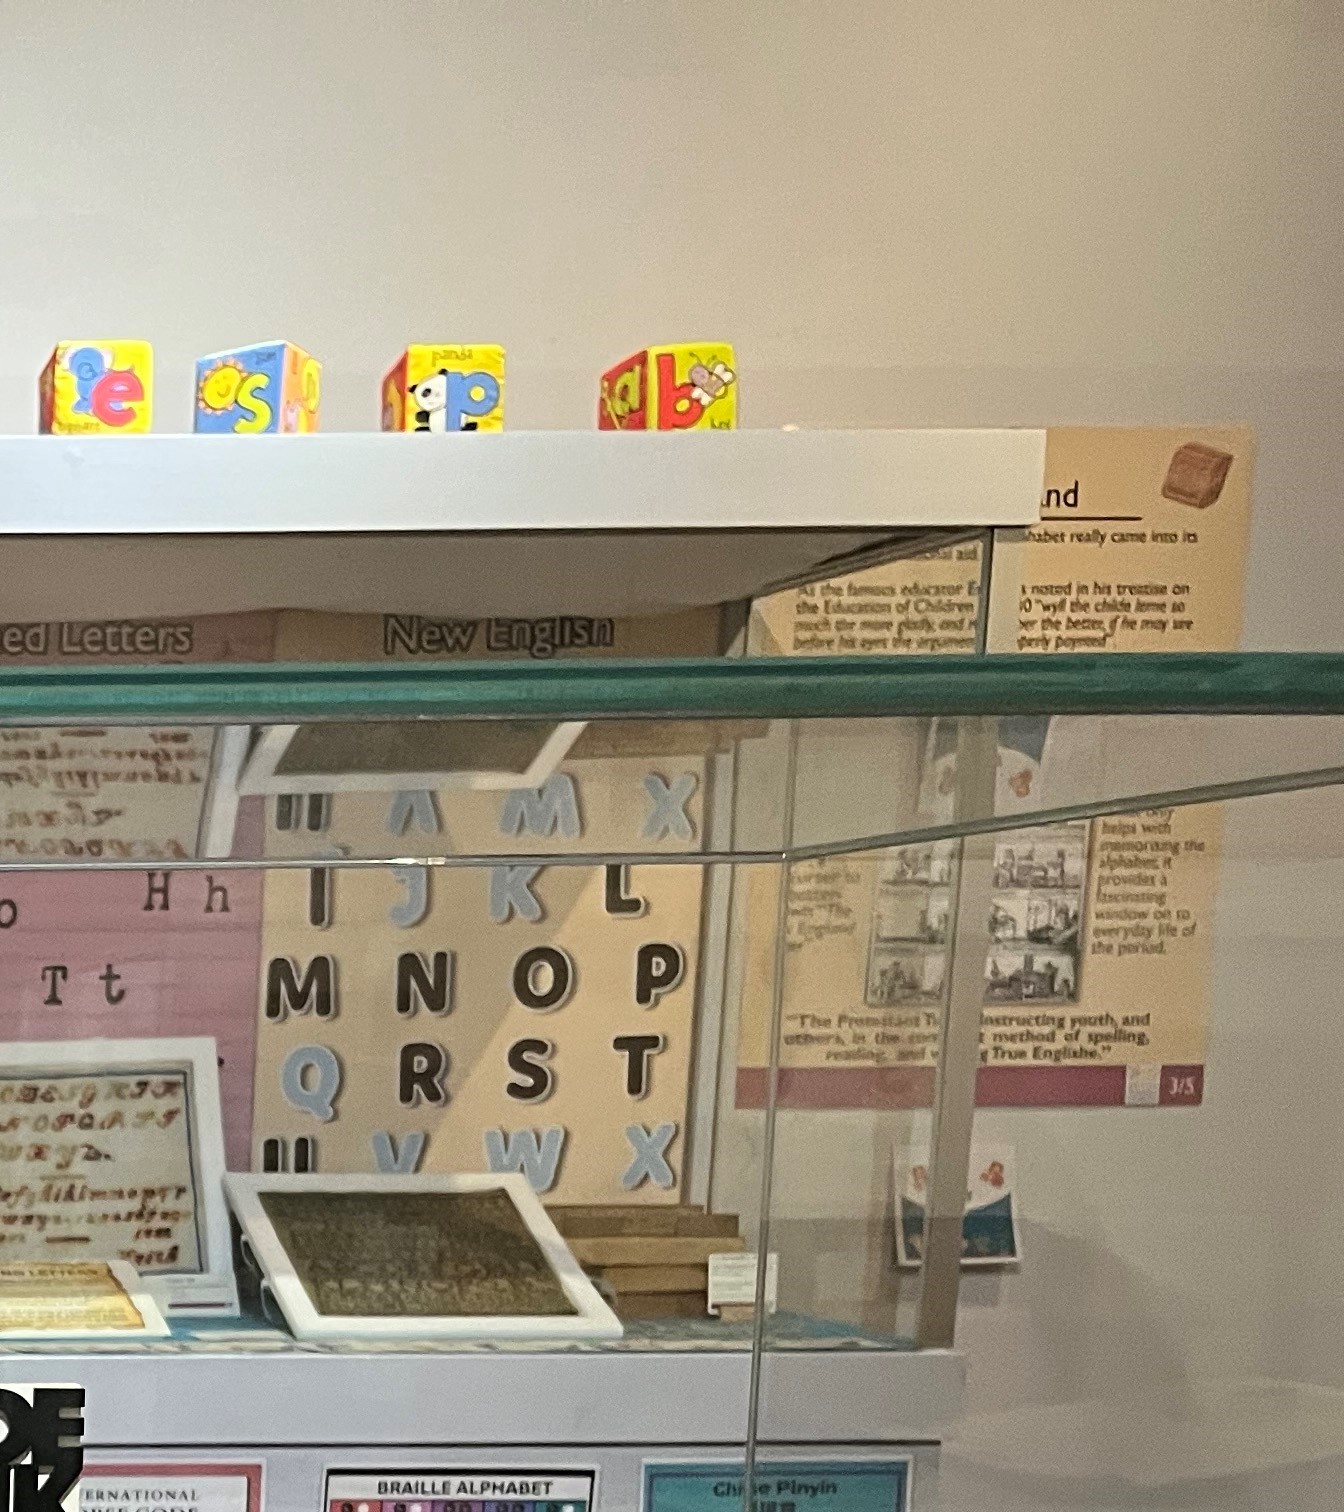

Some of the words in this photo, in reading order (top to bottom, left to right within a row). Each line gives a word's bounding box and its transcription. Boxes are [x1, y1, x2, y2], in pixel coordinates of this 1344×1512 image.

[92, 370, 144, 427] e
[234, 373, 273, 433] s
[445, 372, 500, 432] p
[657, 354, 705, 430] b
[1041, 479, 1079, 507] nd
[1070, 528, 1106, 548] really
[1111, 532, 1146, 543] came
[1152, 530, 1178, 543] into
[1171, 584, 1190, 594] on
[61, 621, 194, 654] Letters
[384, 615, 477, 655] New
[486, 616, 613, 658] English
[143, 871, 172, 911] H
[204, 874, 231, 913] h
[487, 864, 544, 925] K
[605, 864, 647, 917] L
[41, 964, 69, 1007] T
[98, 962, 127, 1007] t
[265, 954, 338, 1021] M
[396, 950, 455, 1016] N
[512, 945, 574, 1012] O
[635, 942, 684, 1010] P
[992, 1030, 1056, 1044] method
[1064, 1029, 1080, 1042] of
[1088, 1029, 1150, 1046] spelling,
[1122, 1012, 1151, 1027] and
[992, 1046, 1027, 1059] True
[280, 1044, 341, 1122] Q
[398, 1041, 447, 1108] R
[505, 1038, 556, 1103] S
[613, 1033, 664, 1100] T
[1169, 1076, 1196, 1095] 3/5
[483, 1124, 565, 1193] W
[622, 1121, 677, 1192] X
[82, 1489, 200, 1501] ERNATIONAL
[377, 1480, 451, 1495] BRAILLE
[456, 1481, 554, 1496] ALPHABET
[777, 1479, 838, 1497] Pinyin
